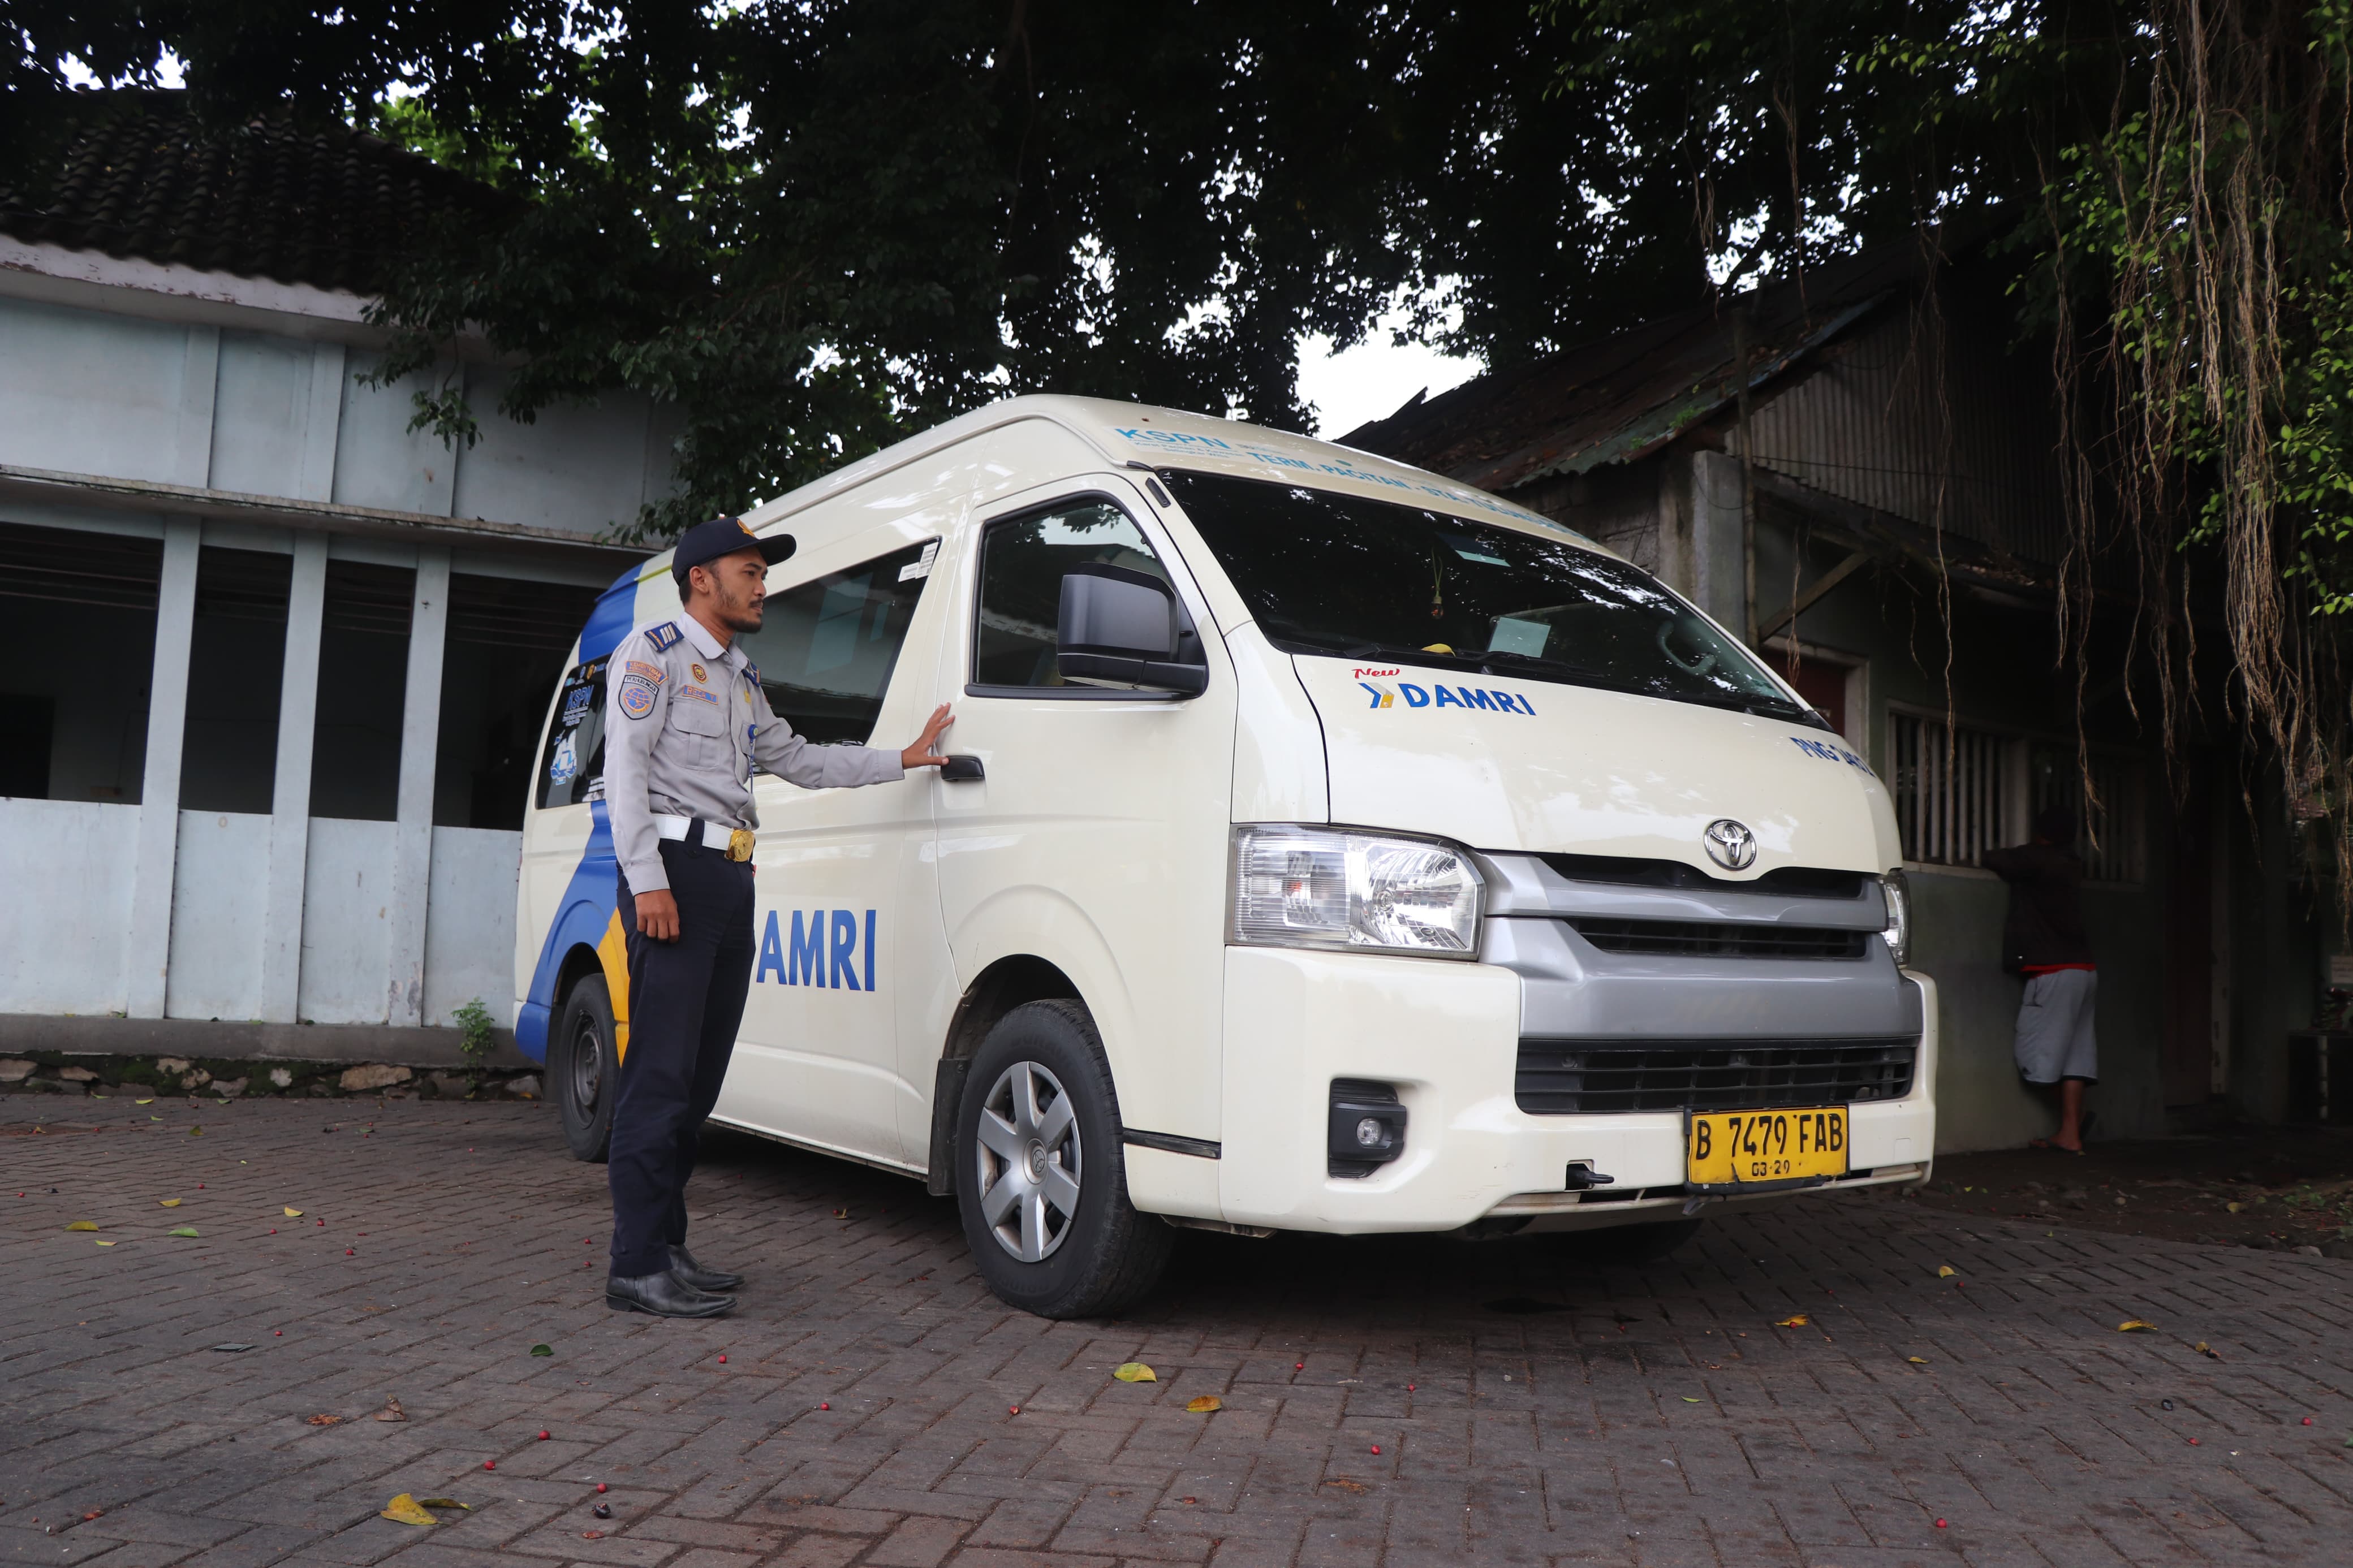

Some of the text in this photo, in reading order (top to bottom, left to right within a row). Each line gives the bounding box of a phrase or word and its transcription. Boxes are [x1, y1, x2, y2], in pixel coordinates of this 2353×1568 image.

[1114, 428, 1231, 450] KSPN
[1246, 452, 1322, 472] TERM.
[1318, 464, 1412, 490] PACITAN
[626, 676, 657, 693] PERHUBUNGAN
[1351, 668, 1400, 679] New
[566, 684, 595, 711] KSPN
[1397, 683, 1537, 716] DAMRI
[1789, 737, 1840, 762] PNG
[756, 909, 877, 992] AMRI
[1695, 1112, 1844, 1161] B 7479 FAB
